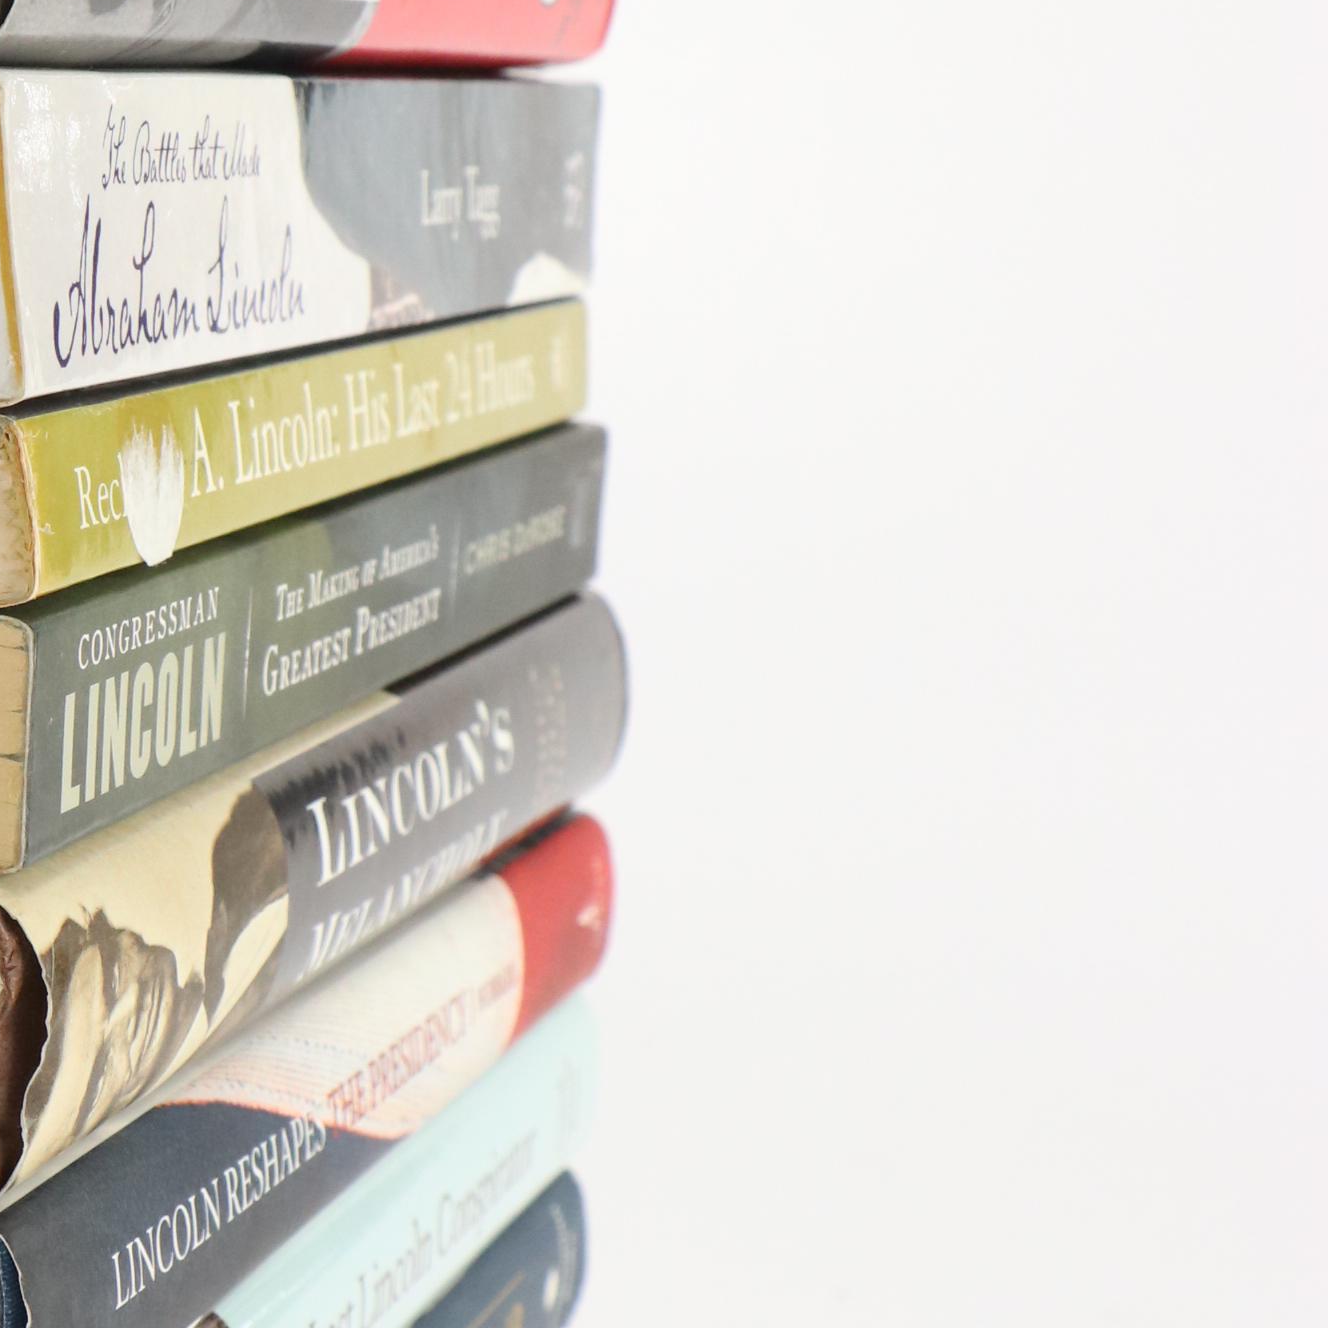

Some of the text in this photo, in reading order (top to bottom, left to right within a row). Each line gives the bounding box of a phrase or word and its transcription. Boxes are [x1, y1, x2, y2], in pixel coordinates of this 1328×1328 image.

[102, 104, 261, 190] The Battles that Made
[53, 194, 305, 368] Abraham Lincoln
[190, 406, 225, 498] A.
[227, 382, 341, 486] Lincoln:
[343, 369, 391, 452] His
[392, 362, 440, 439] Last
[78, 586, 220, 670] CONGRESSMAN
[262, 644, 352, 697] GREATEST
[60, 631, 227, 814] LINCOLN
[306, 699, 515, 888] LINCOLN'S
[111, 1177, 222, 1311] LINCOLN
[223, 1109, 327, 1224] RESHAPES
[327, 1067, 370, 1130] THE
[368, 986, 474, 1112] PRESIDENCY
